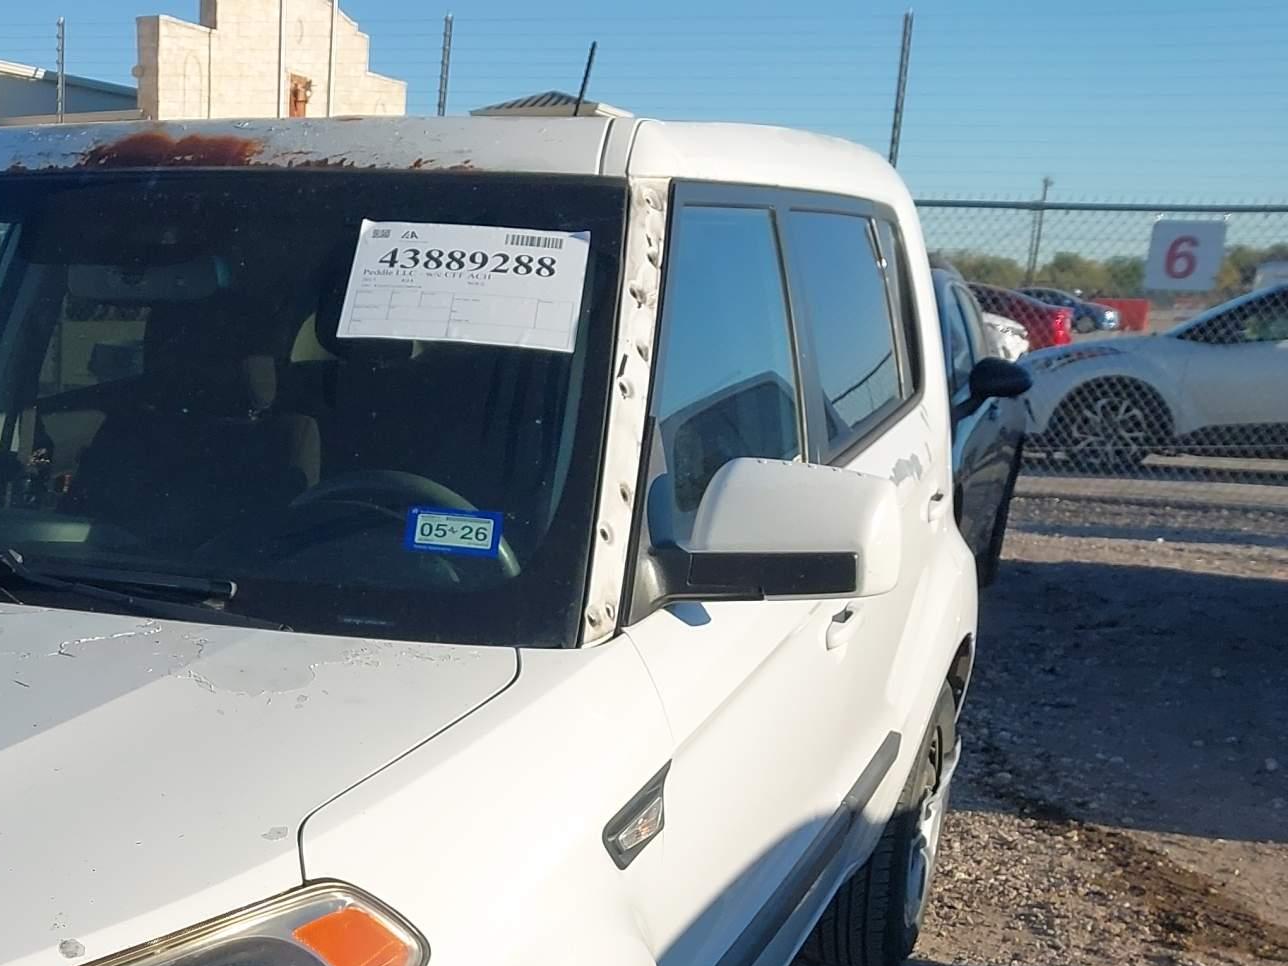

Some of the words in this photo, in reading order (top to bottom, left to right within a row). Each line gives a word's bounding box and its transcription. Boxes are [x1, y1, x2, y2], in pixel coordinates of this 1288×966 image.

[378, 247, 556, 278] 43889288
[1164, 235, 1199, 279] 6
[420, 522, 448, 538] 05
[460, 525, 488, 541] 26
